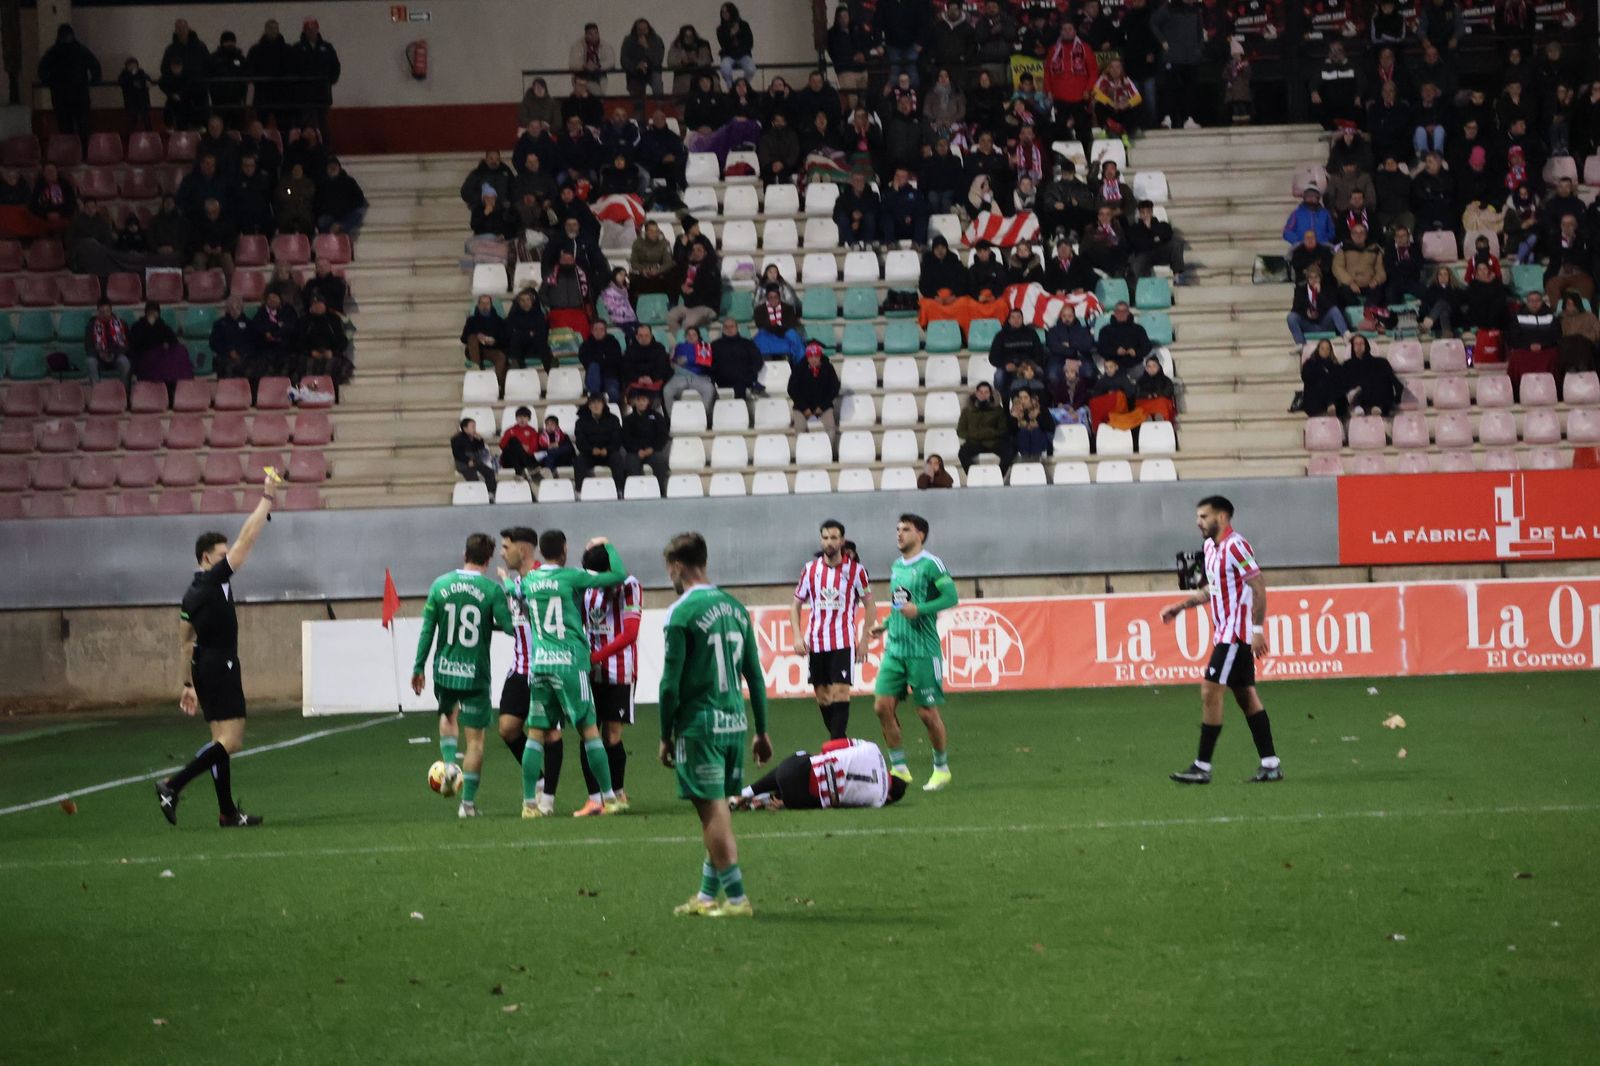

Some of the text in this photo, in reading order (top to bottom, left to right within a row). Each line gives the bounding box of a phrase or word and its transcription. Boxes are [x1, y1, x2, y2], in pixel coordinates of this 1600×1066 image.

[1372, 530, 1397, 545] LA
[1403, 526, 1491, 543] FÁBRICA
[1529, 526, 1555, 541] DE
[1561, 525, 1587, 539] LA
[444, 602, 482, 648] 18
[529, 596, 566, 640] 14
[1093, 598, 1374, 664] La Onión
[1466, 583, 1529, 650] La
[706, 631, 744, 694] 17
[1115, 663, 1136, 681] El
[1262, 658, 1344, 676] Zamora
[1487, 649, 1587, 668] El Correo
